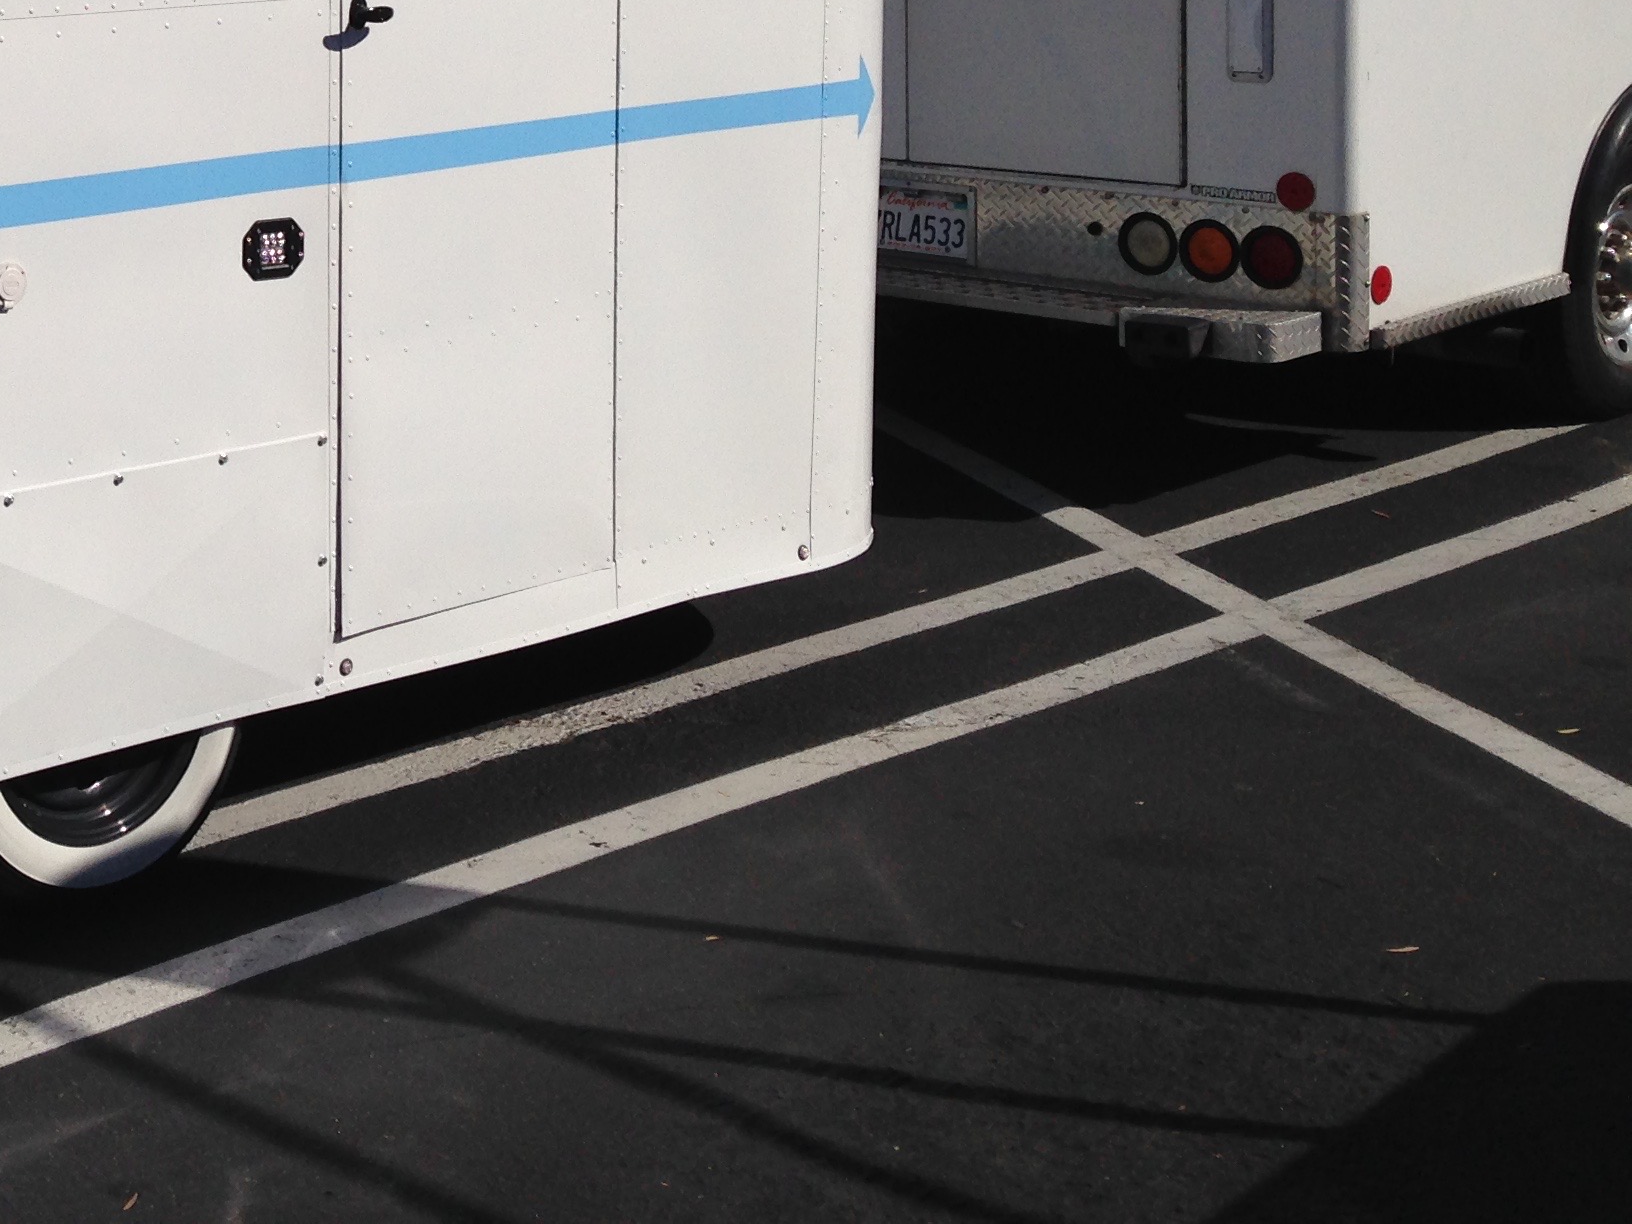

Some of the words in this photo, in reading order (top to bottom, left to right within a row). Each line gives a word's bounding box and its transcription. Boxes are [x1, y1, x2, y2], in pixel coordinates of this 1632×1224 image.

[886, 190, 951, 211] California
[1201, 185, 1228, 199] PRO
[1229, 187, 1275, 203] ARMOR
[877, 209, 966, 249] RLA533
